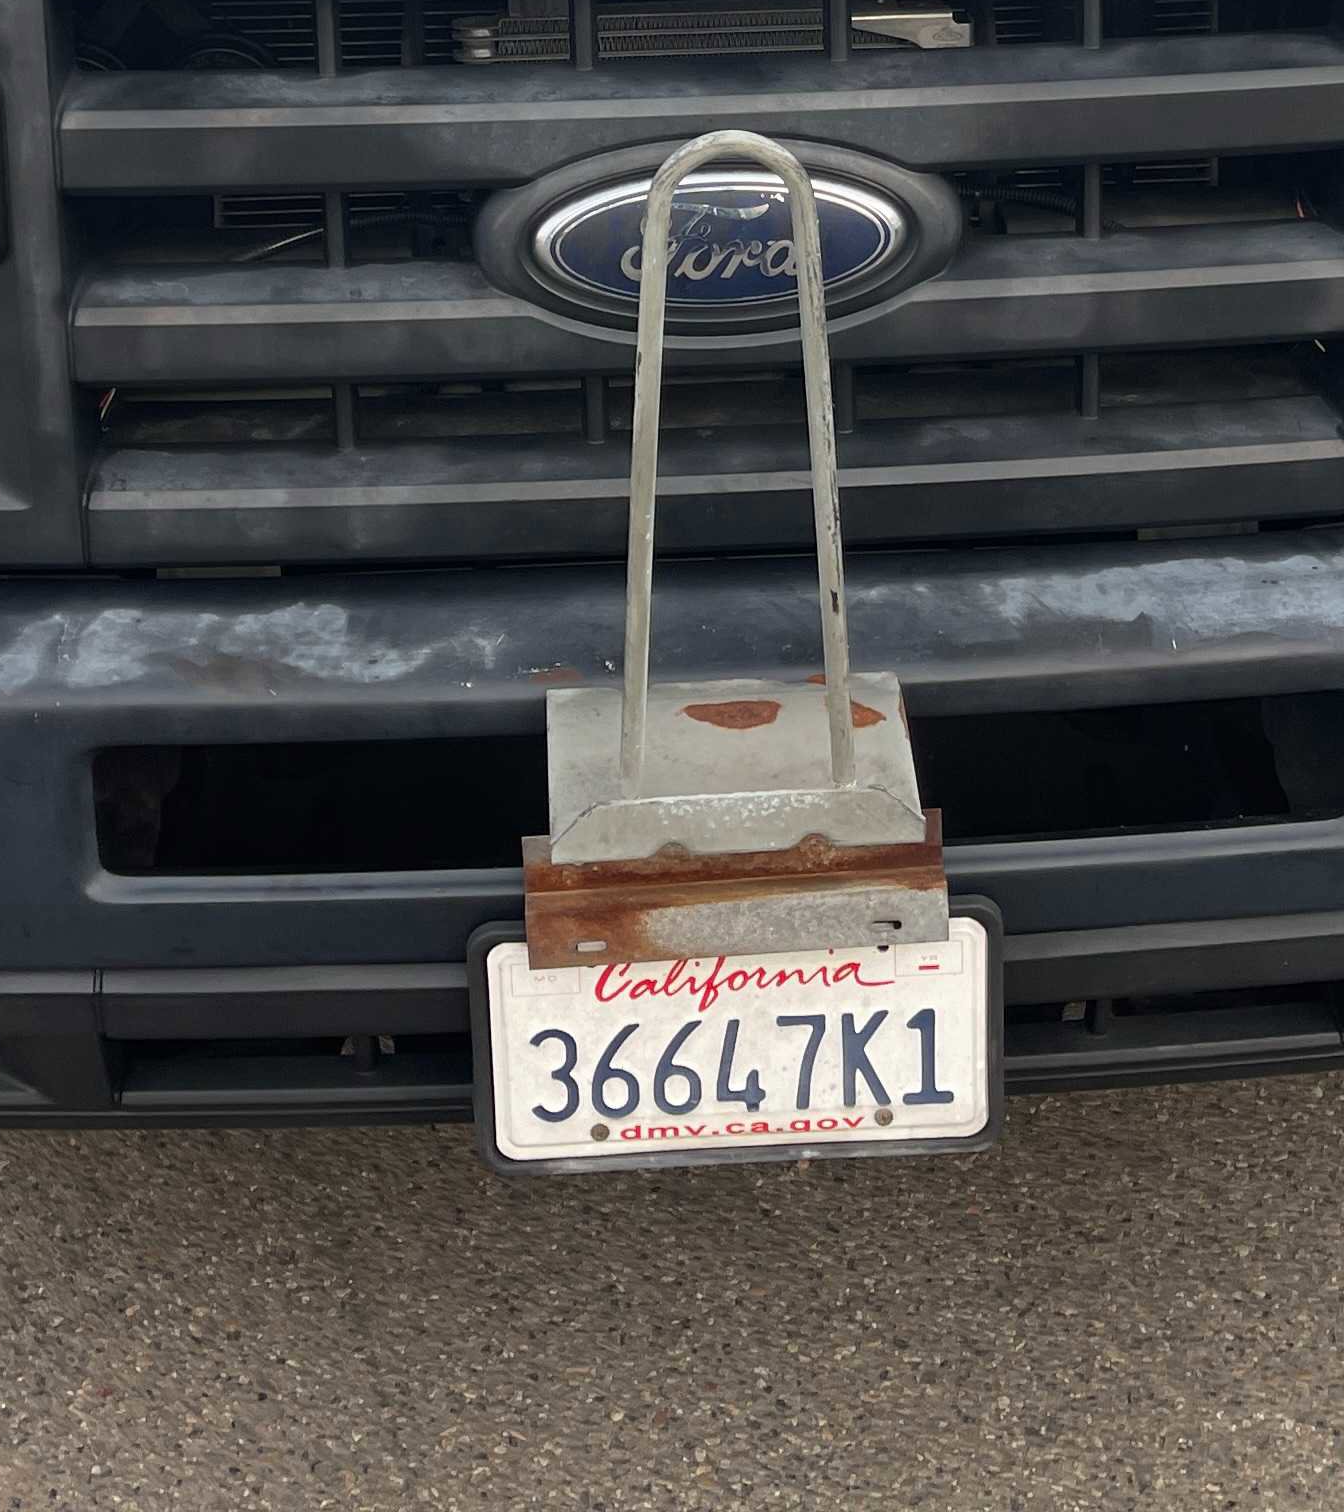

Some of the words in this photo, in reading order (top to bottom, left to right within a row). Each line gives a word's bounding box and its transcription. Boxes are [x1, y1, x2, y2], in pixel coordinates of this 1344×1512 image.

[594, 948, 896, 1012] California
[528, 1007, 955, 1124] 36647K1
[619, 1113, 866, 1142] dmv.ca.gov
